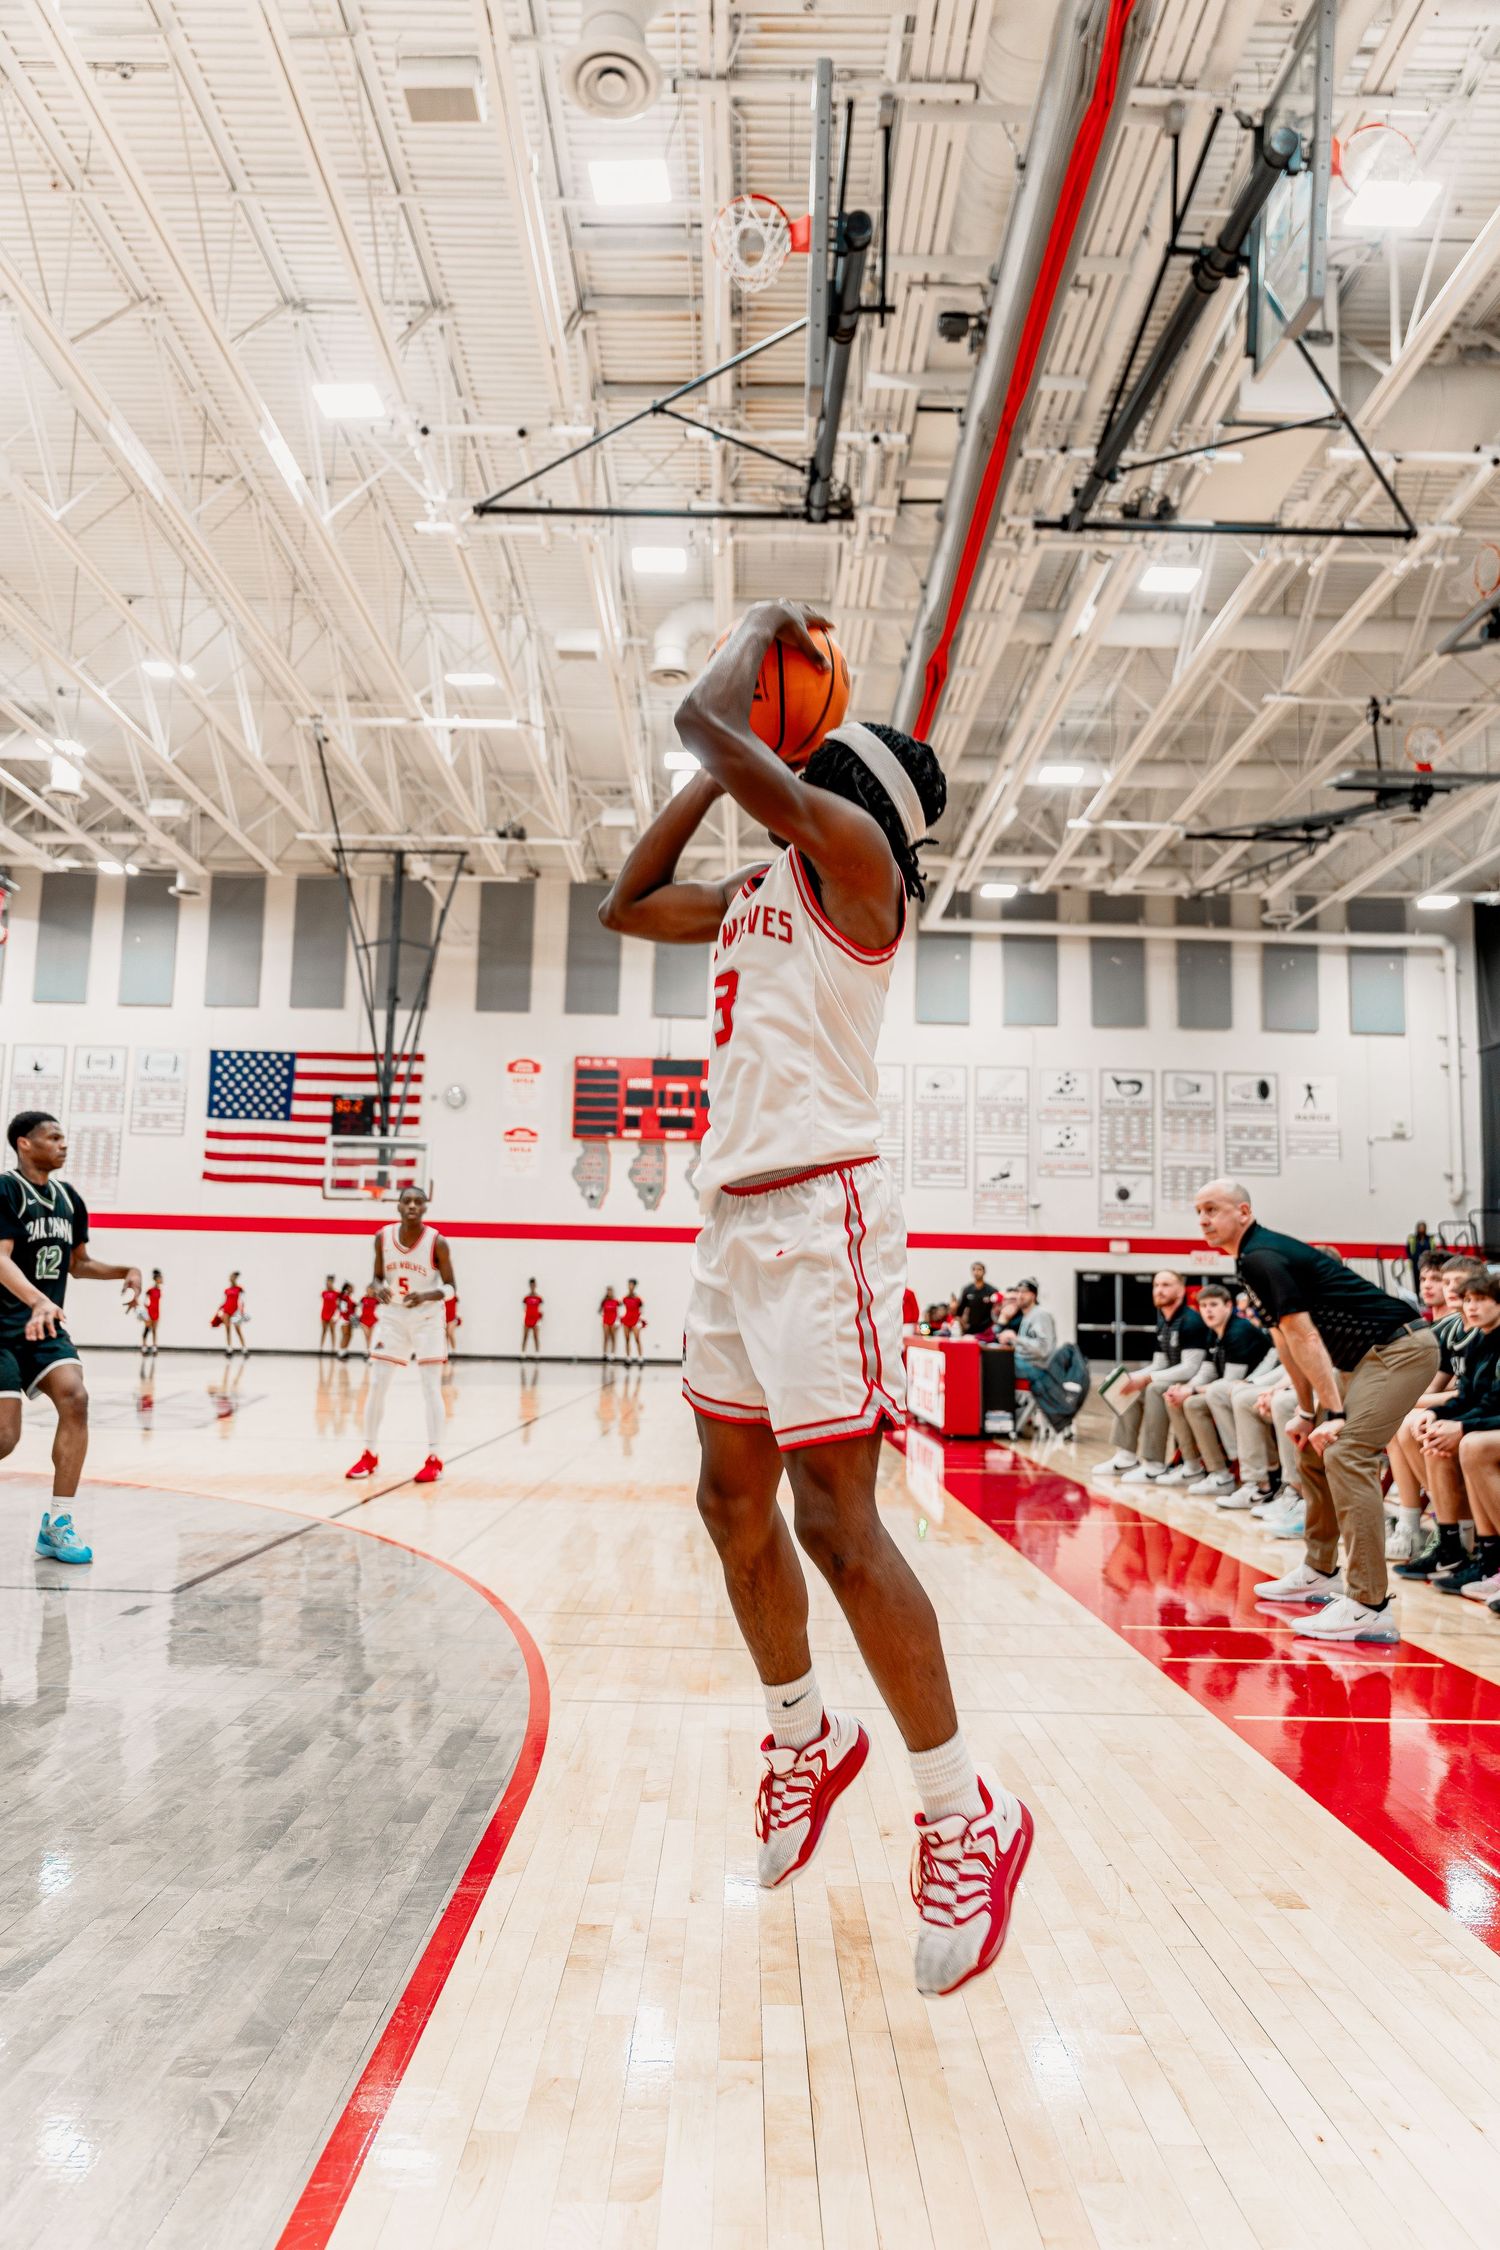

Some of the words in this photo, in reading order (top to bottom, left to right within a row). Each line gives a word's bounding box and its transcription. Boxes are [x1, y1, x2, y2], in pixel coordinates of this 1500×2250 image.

[722, 905, 793, 945] WVES
[35, 1245, 62, 1280] 12
[398, 1277, 410, 1296] 5
